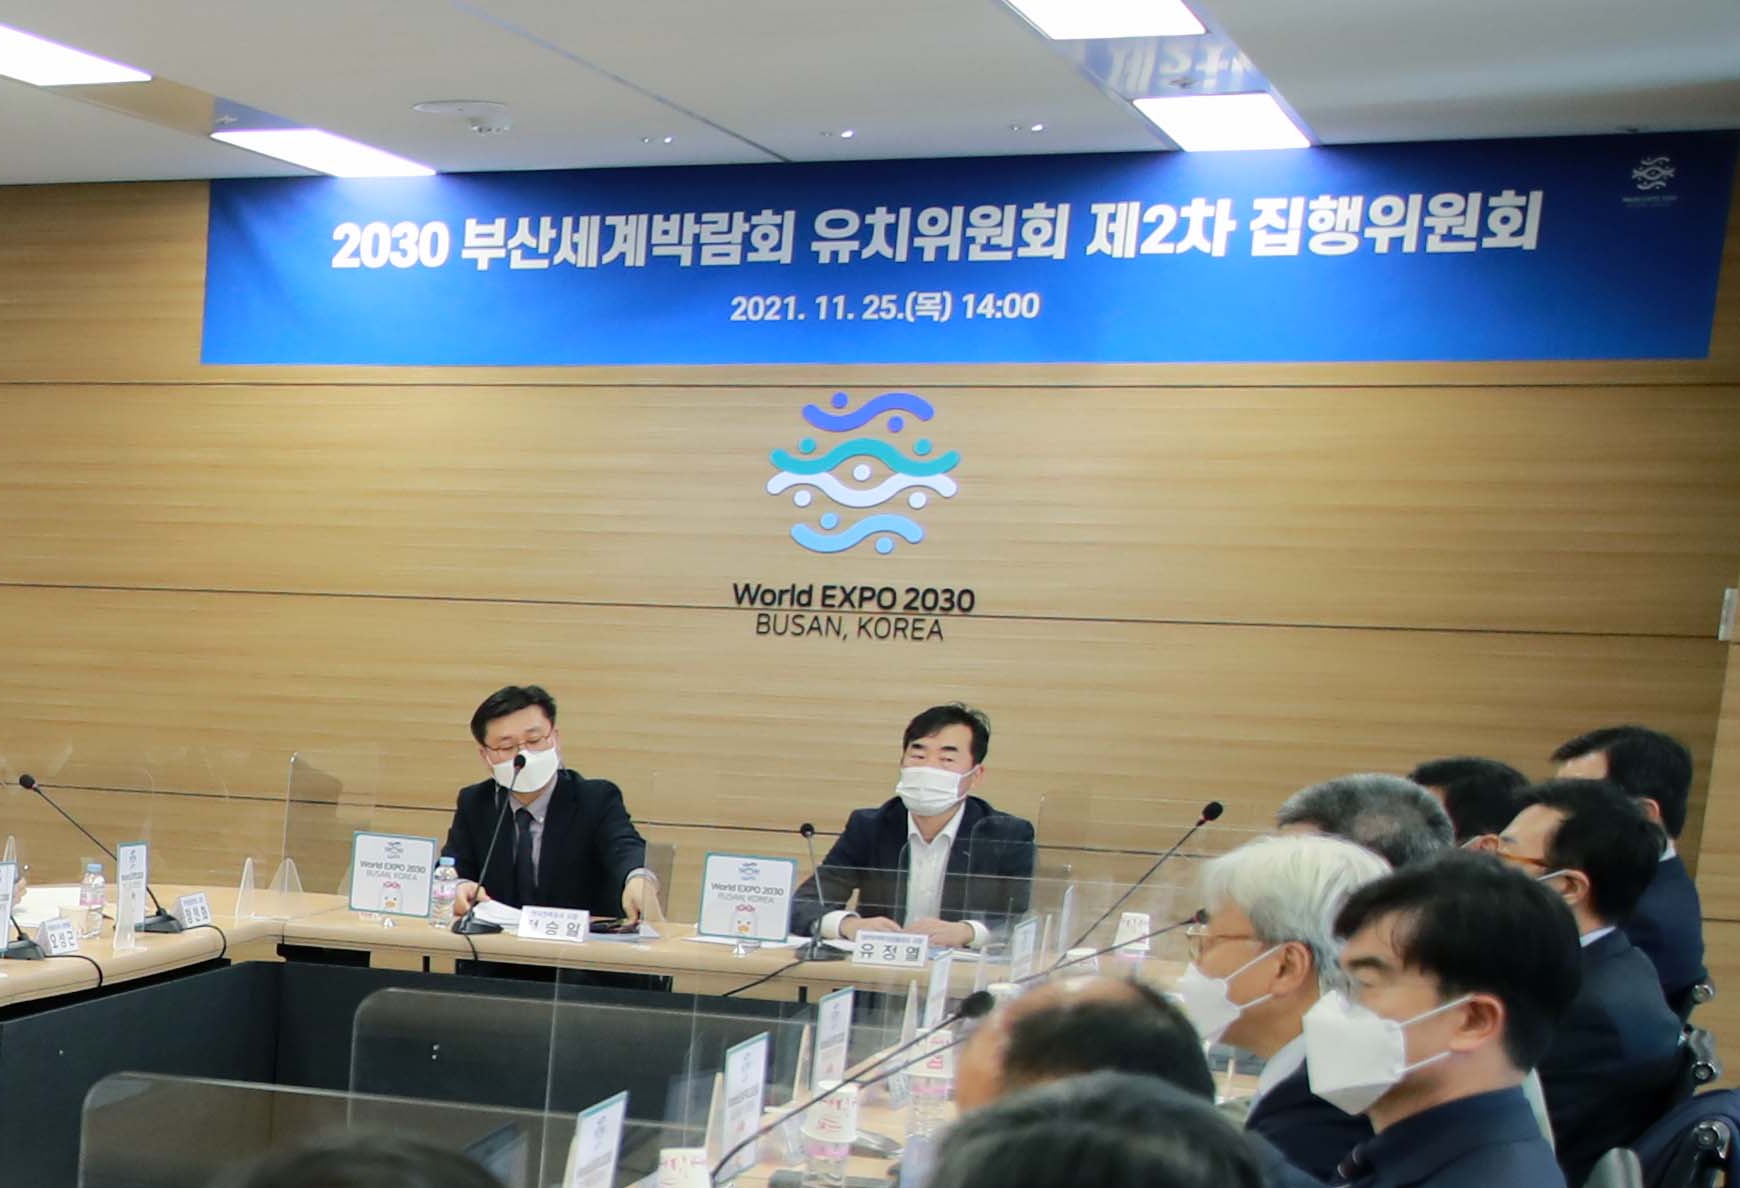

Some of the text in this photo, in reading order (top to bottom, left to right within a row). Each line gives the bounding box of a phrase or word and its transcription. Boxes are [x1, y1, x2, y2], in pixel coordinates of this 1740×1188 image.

[332, 189, 1542, 272] 2030 부산세계박람회 유치위원회 제2차 집행위원회
[730, 296, 806, 322] 2021.
[815, 295, 855, 321] 11.
[961, 292, 1041, 320] 14:00
[732, 582, 975, 613] World EXPO 2030
[756, 612, 944, 641] BUSAN, KOREA
[860, 943, 920, 961] 유정열
